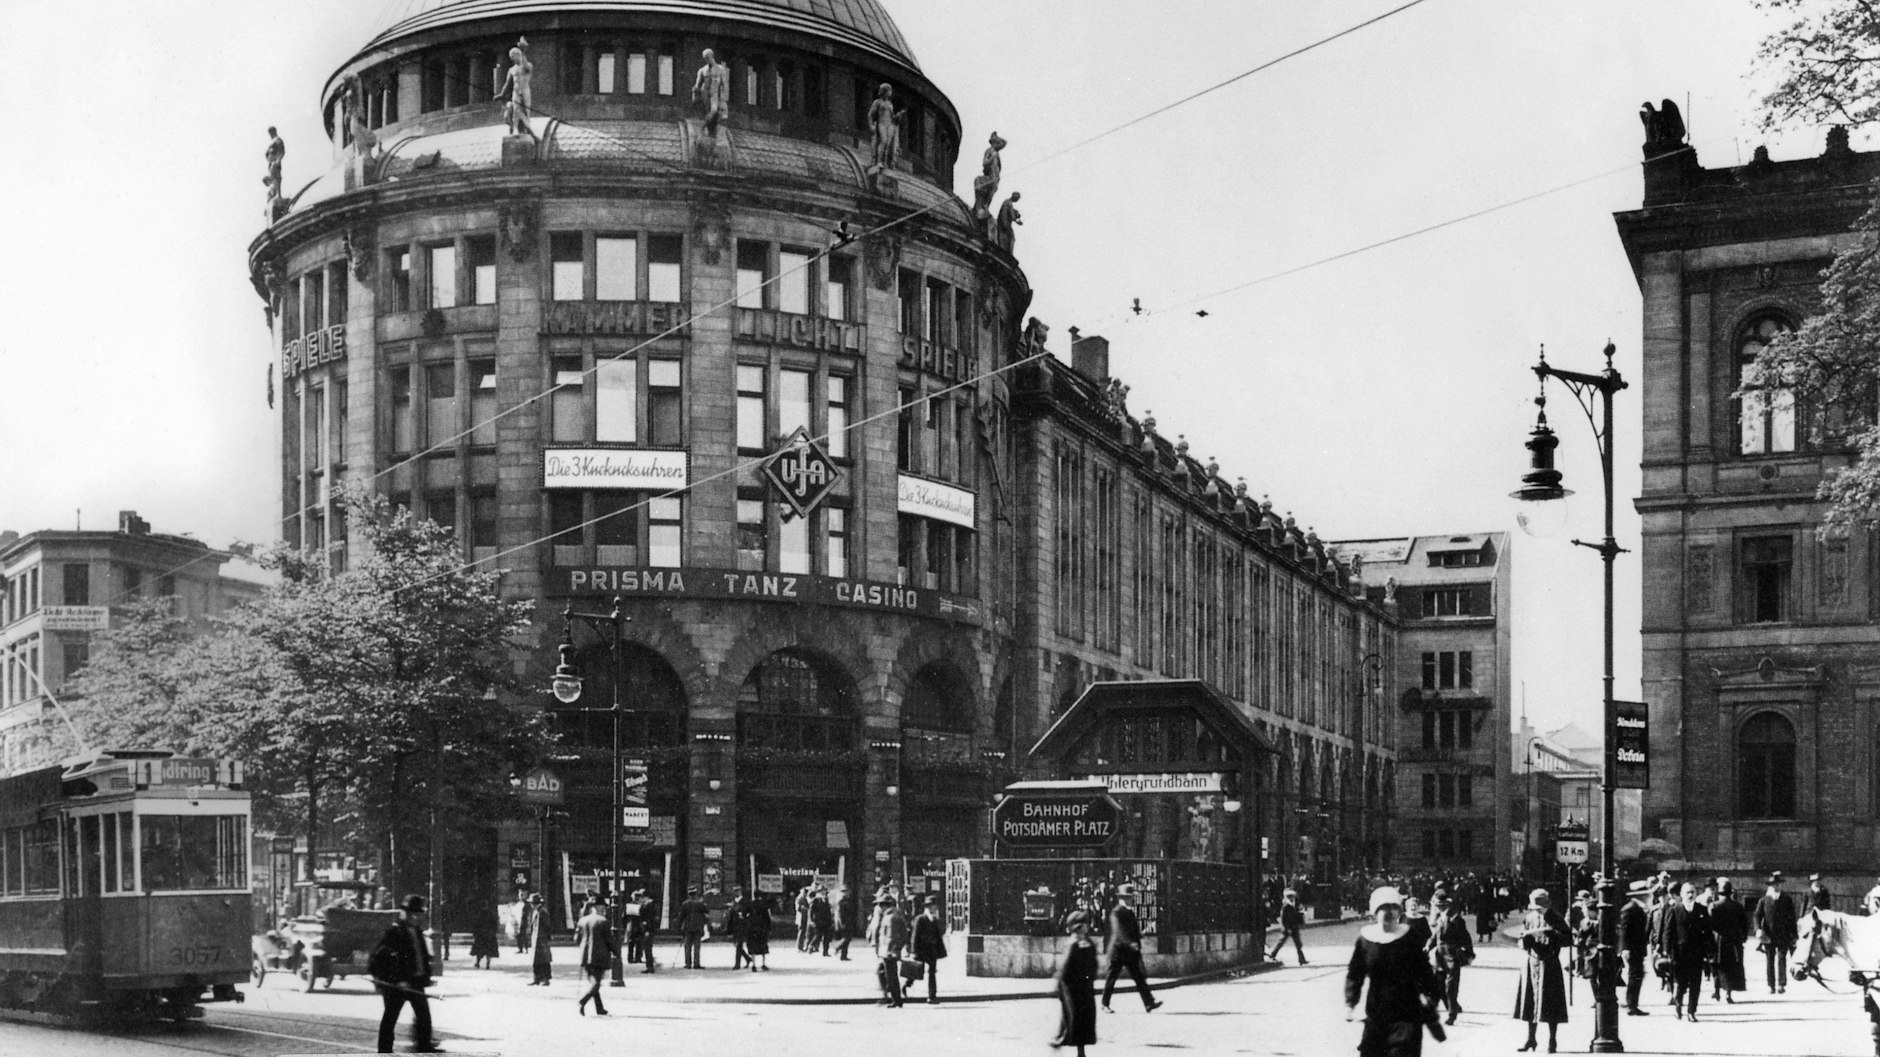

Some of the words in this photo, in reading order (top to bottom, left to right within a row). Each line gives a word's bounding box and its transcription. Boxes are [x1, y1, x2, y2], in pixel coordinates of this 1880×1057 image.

[282, 323, 343, 378] SPIELE
[547, 456, 570, 476] Die
[572, 456, 580, 476] 3
[571, 570, 685, 592] PRISMA
[724, 573, 797, 597] TANZ
[836, 581, 917, 609] CASINO
[162, 761, 210, 783] dtring
[527, 773, 560, 791] BAD
[1023, 803, 1089, 816] BAHNHOF
[1003, 820, 1070, 836] POTSDAMER
[1074, 820, 1109, 836] PLATZ
[1560, 846, 1569, 856] 12
[593, 868, 640, 877] Vateland
[779, 867, 819, 876] Vaterland
[171, 946, 221, 965] 3057
